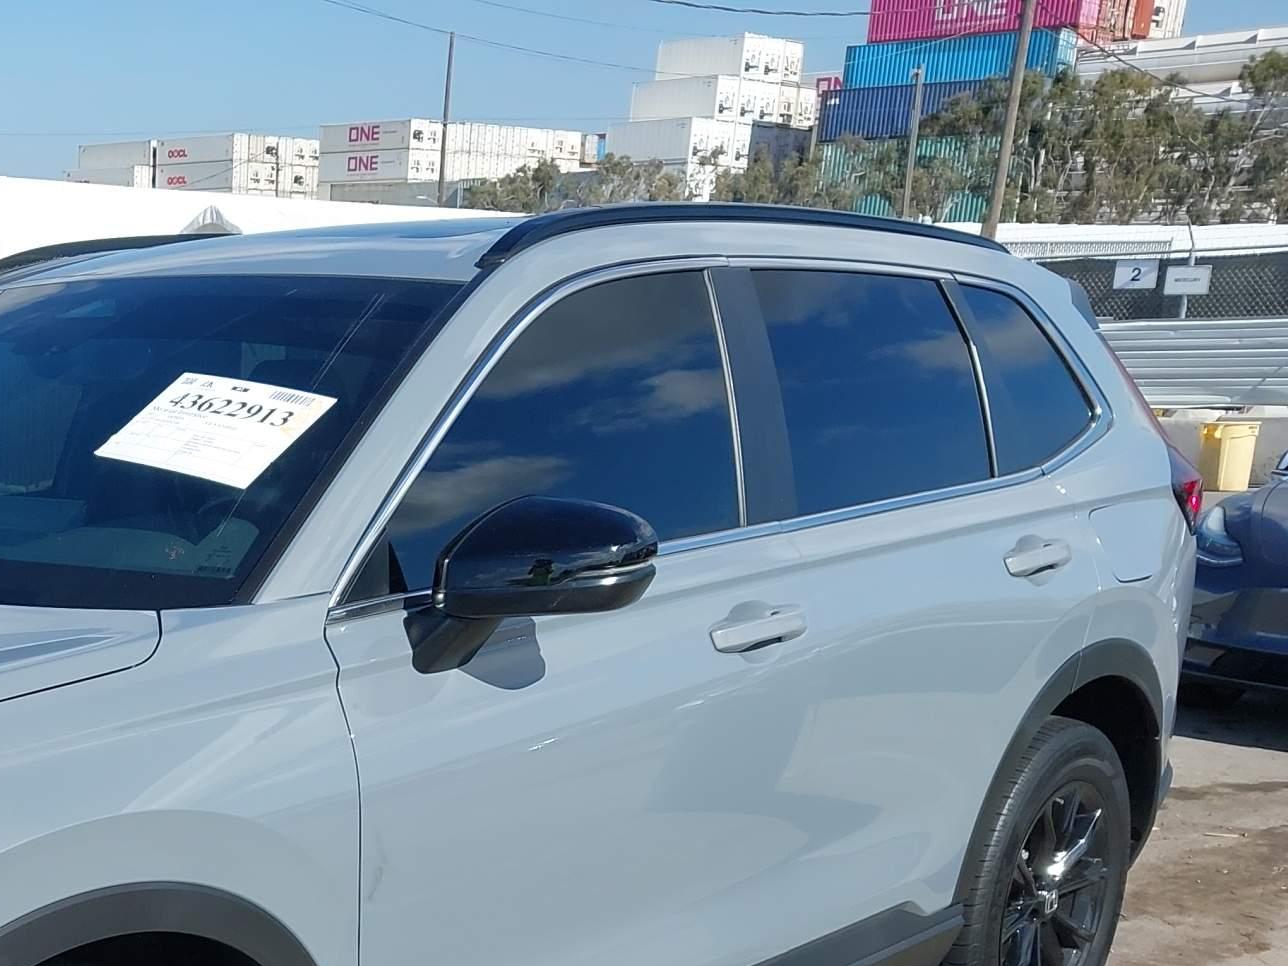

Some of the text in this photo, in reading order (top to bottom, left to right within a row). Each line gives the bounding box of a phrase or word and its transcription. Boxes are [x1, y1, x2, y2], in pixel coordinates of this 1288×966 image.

[348, 125, 380, 143] ONE
[167, 149, 188, 159] OOCL
[347, 155, 379, 172] ONE
[167, 176, 187, 185] OOCL
[1129, 267, 1142, 282] 2
[169, 392, 295, 427] 43622913
